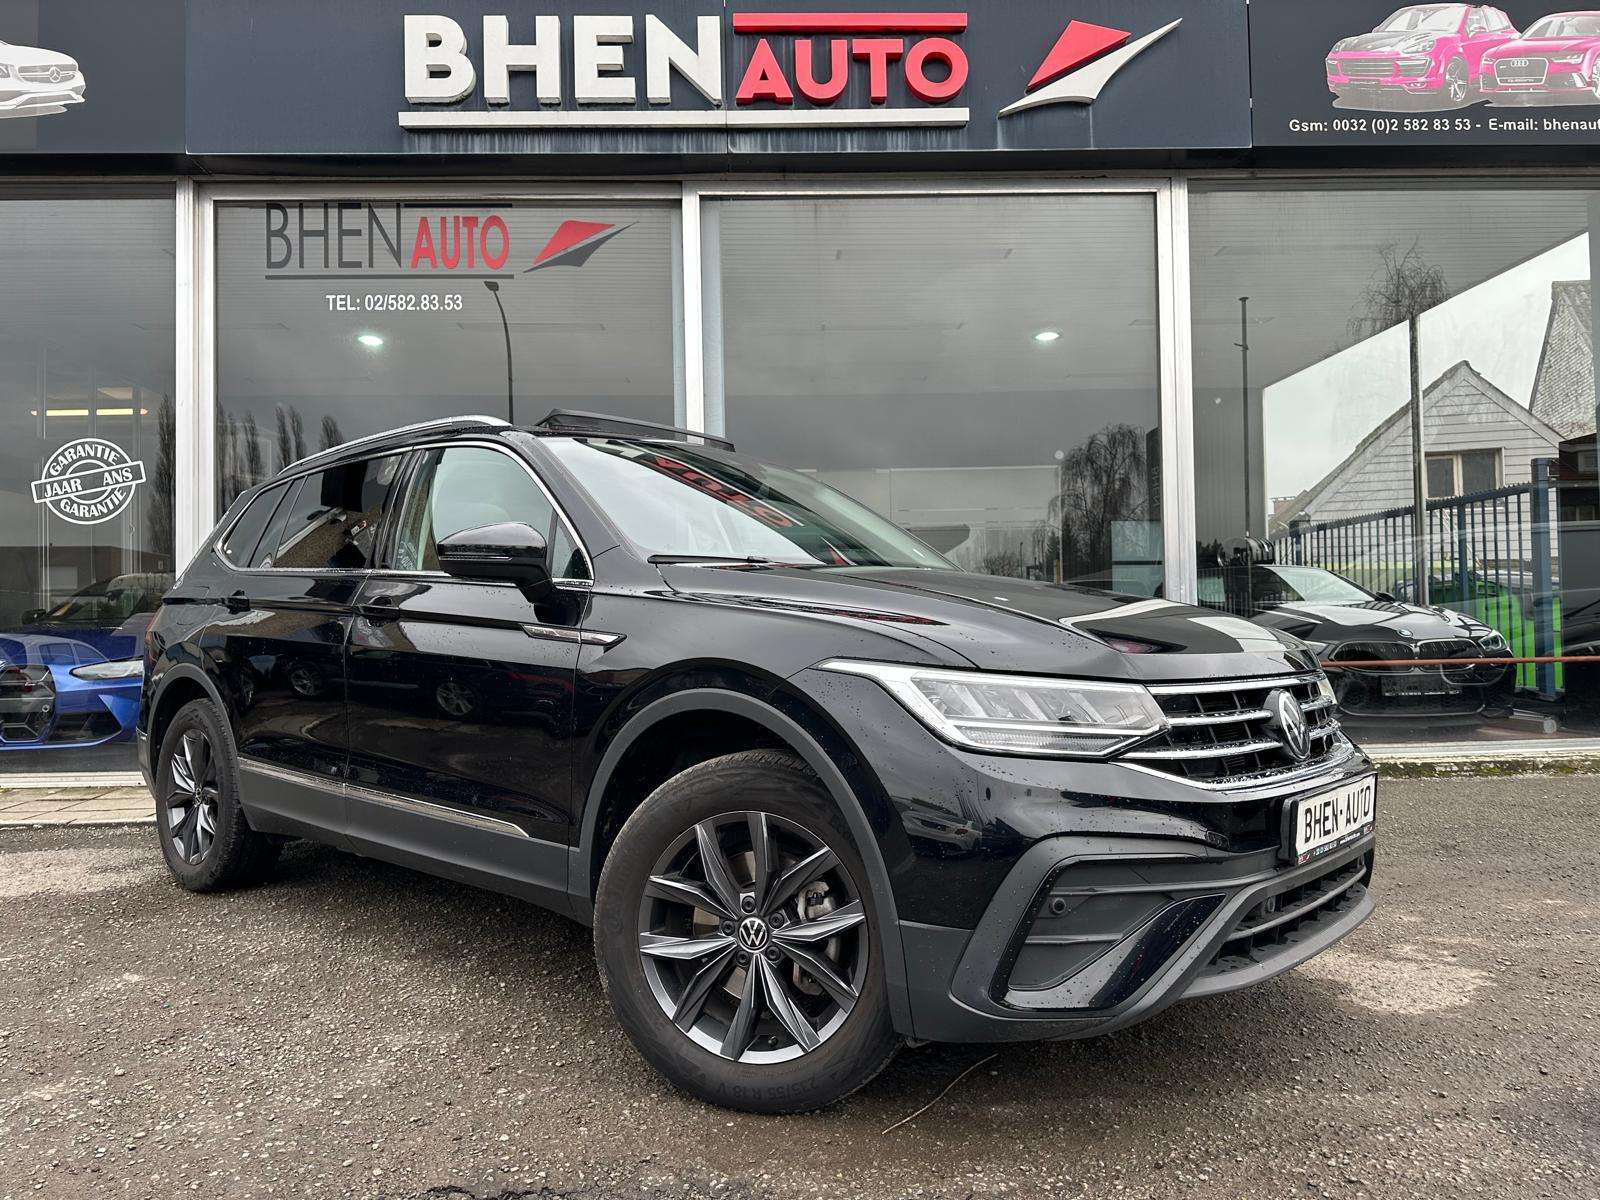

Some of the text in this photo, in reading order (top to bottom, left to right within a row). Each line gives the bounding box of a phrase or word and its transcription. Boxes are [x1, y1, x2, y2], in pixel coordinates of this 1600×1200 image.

[403, 14, 969, 106] BHEN AUTO
[1289, 118, 1329, 132] Gsm:
[1332, 118, 1367, 131] 0032
[1371, 118, 1399, 134] (0)2
[1403, 118, 1429, 131] 582
[1433, 118, 1450, 131] 83
[1454, 118, 1471, 131] 53
[1488, 118, 1538, 131] E-mail:
[265, 202, 510, 270] BHEN AUTO
[326, 294, 463, 311] TEL: 02/582.83.53
[49, 443, 120, 476] GARANTIE
[44, 467, 133, 498] JAAR ANS
[60, 486, 127, 518] GARANTIE
